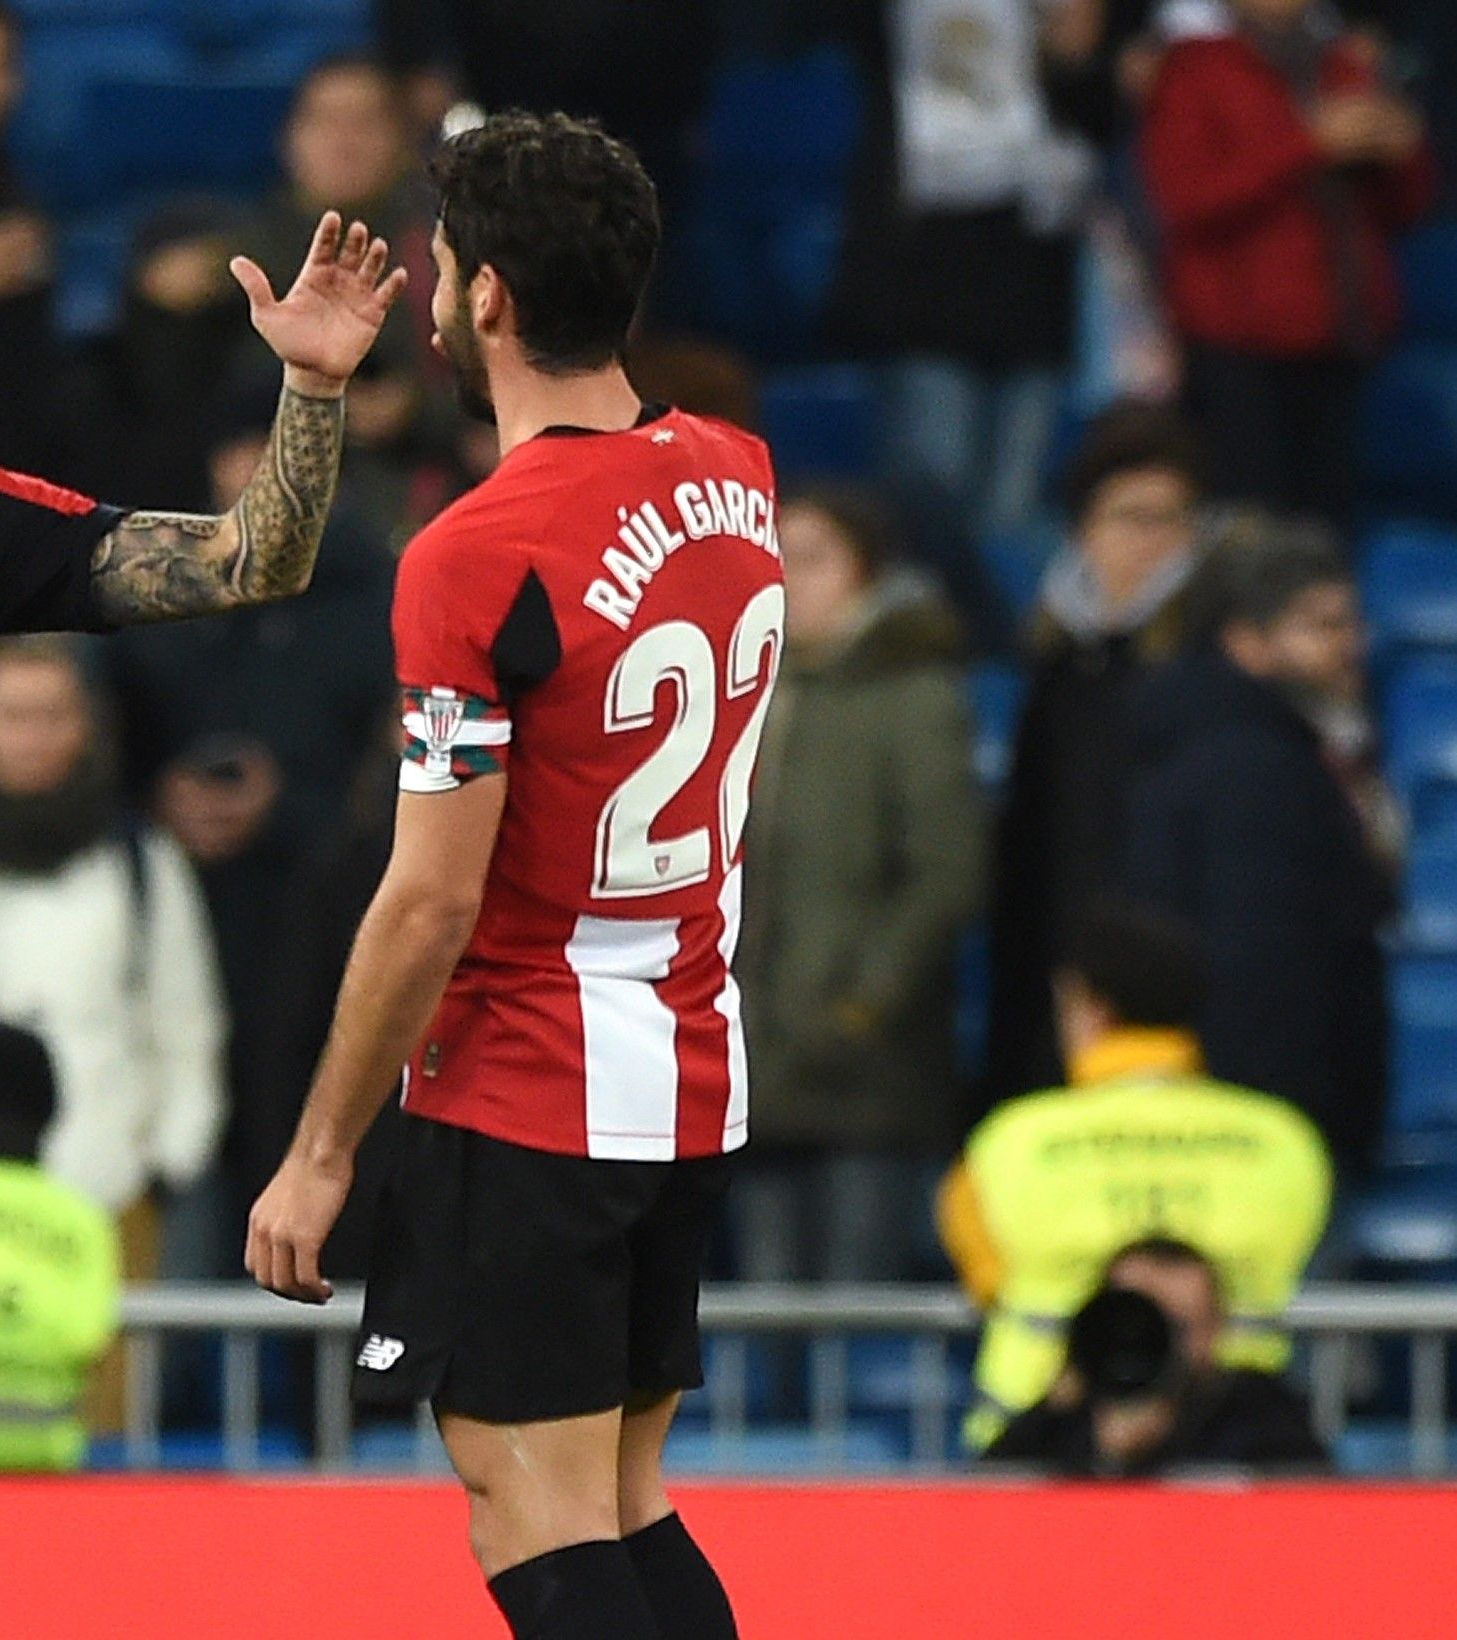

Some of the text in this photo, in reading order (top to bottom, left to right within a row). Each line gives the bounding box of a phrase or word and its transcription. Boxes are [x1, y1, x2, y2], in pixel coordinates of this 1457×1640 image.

[583, 478, 779, 631] RAÚL GARCÍ
[590, 583, 784, 899] 22
